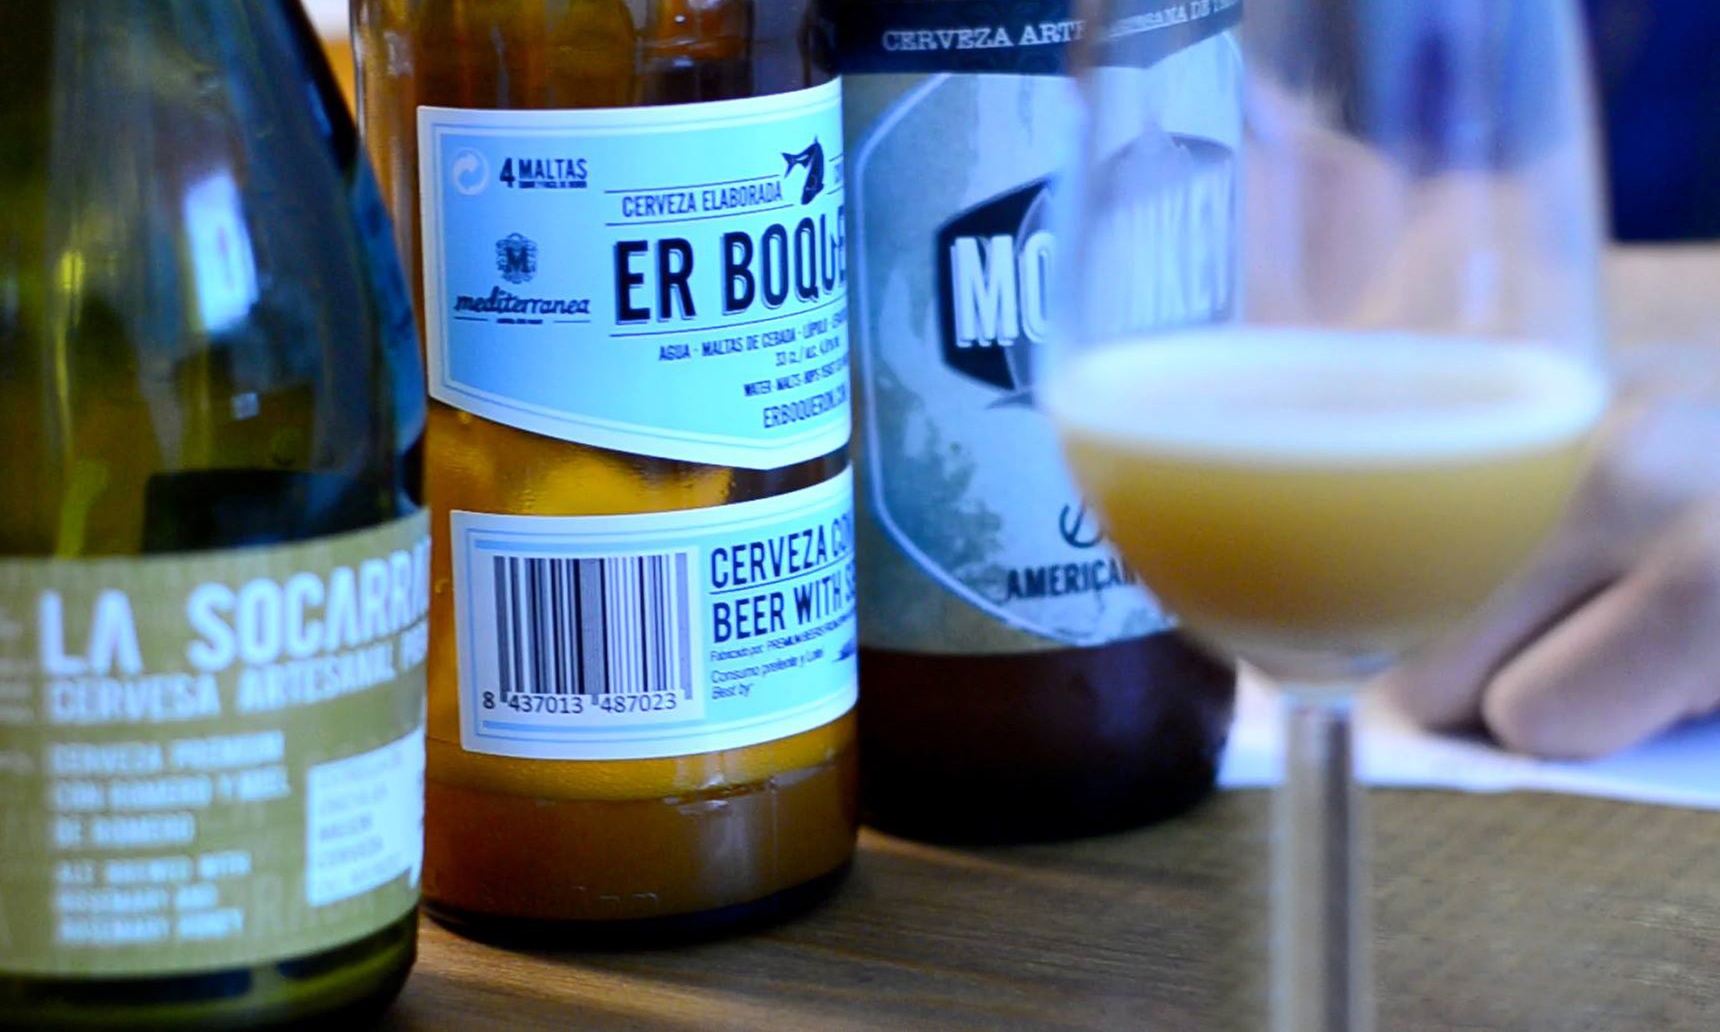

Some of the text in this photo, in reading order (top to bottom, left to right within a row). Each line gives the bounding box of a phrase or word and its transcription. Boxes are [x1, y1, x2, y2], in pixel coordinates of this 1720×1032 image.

[882, 28, 1014, 51] CERVEZA
[500, 157, 588, 188] 4 MALTAS
[622, 181, 784, 218] CERVEZA ELABORADA
[612, 237, 697, 325] ER
[453, 285, 591, 315] mediterranea
[659, 343, 691, 361] AGUA
[702, 336, 743, 357] MALTAS
[746, 333, 760, 351] DE
[761, 327, 796, 348] CEBADA
[744, 380, 772, 398] WATER
[711, 523, 828, 590] CERVEZA
[712, 591, 785, 644] BEER
[794, 569, 843, 626] WITH
[39, 588, 145, 673] LA
[711, 665, 760, 684] Consumo
[47, 671, 223, 726] CERVESA
[482, 690, 677, 715] 8 437013 487023
